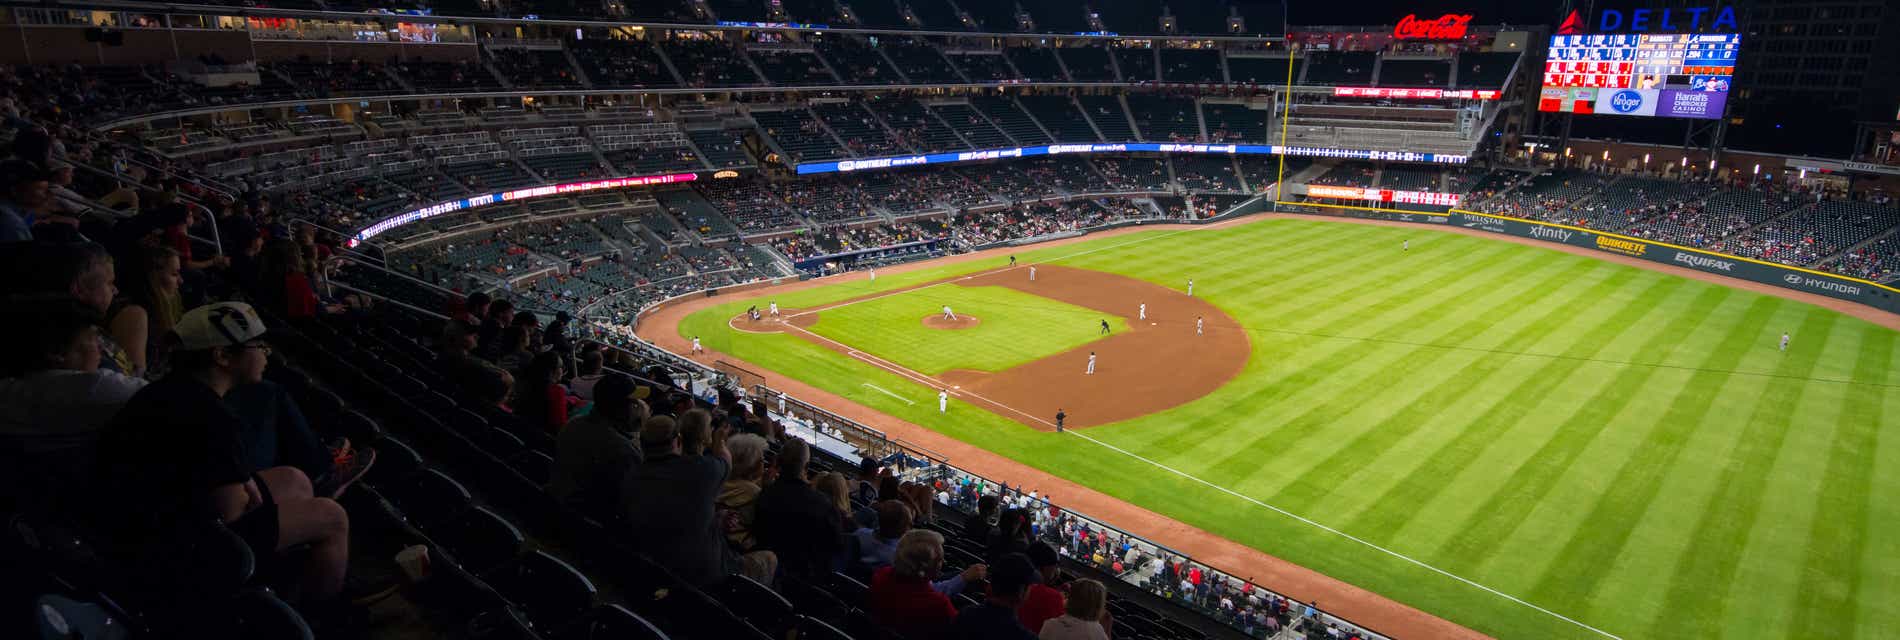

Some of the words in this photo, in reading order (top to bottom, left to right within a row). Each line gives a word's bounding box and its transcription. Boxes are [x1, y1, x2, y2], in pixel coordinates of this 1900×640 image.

[1394, 14, 1473, 39] Coca-Cola
[1600, 6, 1737, 31] DELTA
[1613, 93, 1641, 112] Kroger
[1529, 224, 1572, 242] xfinity
[1596, 236, 1647, 253] QUIKRETE
[1675, 252, 1735, 271] EQUIFAX
[1805, 278, 1860, 296] HYUNDAI
